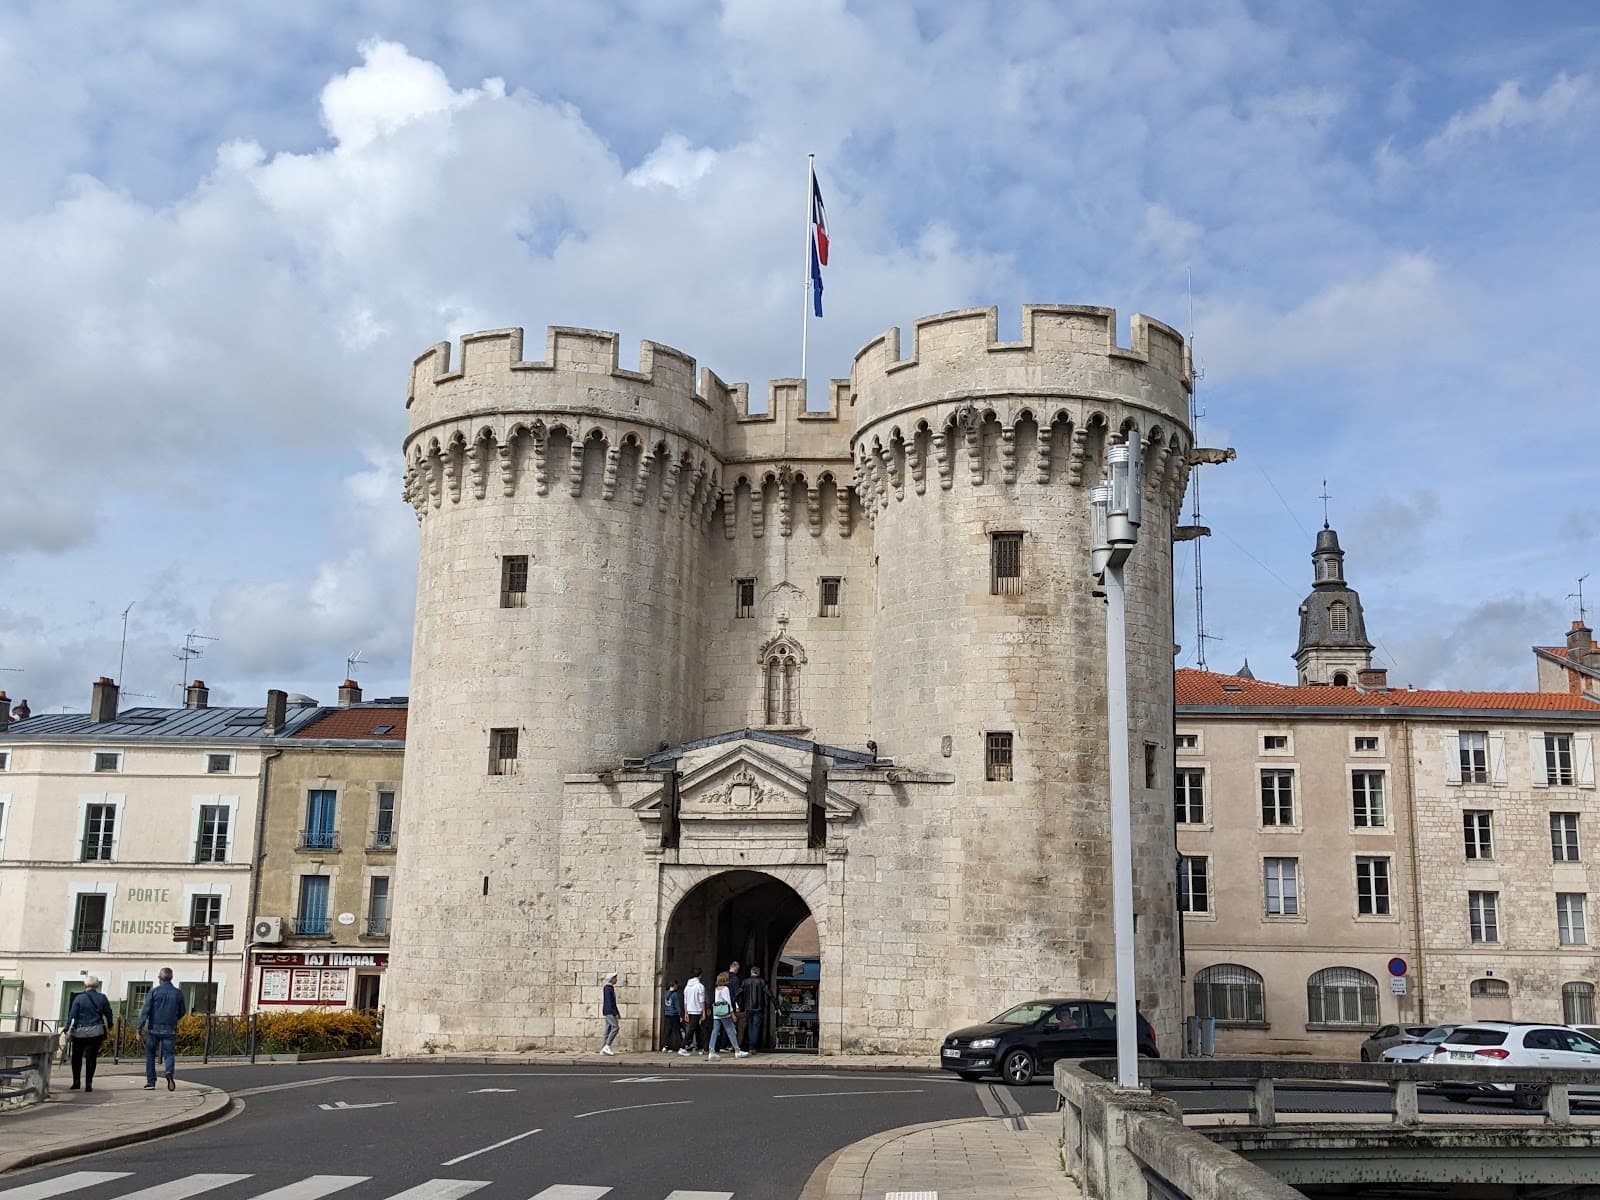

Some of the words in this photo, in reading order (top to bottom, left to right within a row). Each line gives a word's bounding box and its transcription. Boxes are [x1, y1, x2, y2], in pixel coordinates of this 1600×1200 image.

[128, 888, 169, 903] PORTE
[304, 952, 325, 966] TAJ
[329, 953, 377, 966] MAHAL
